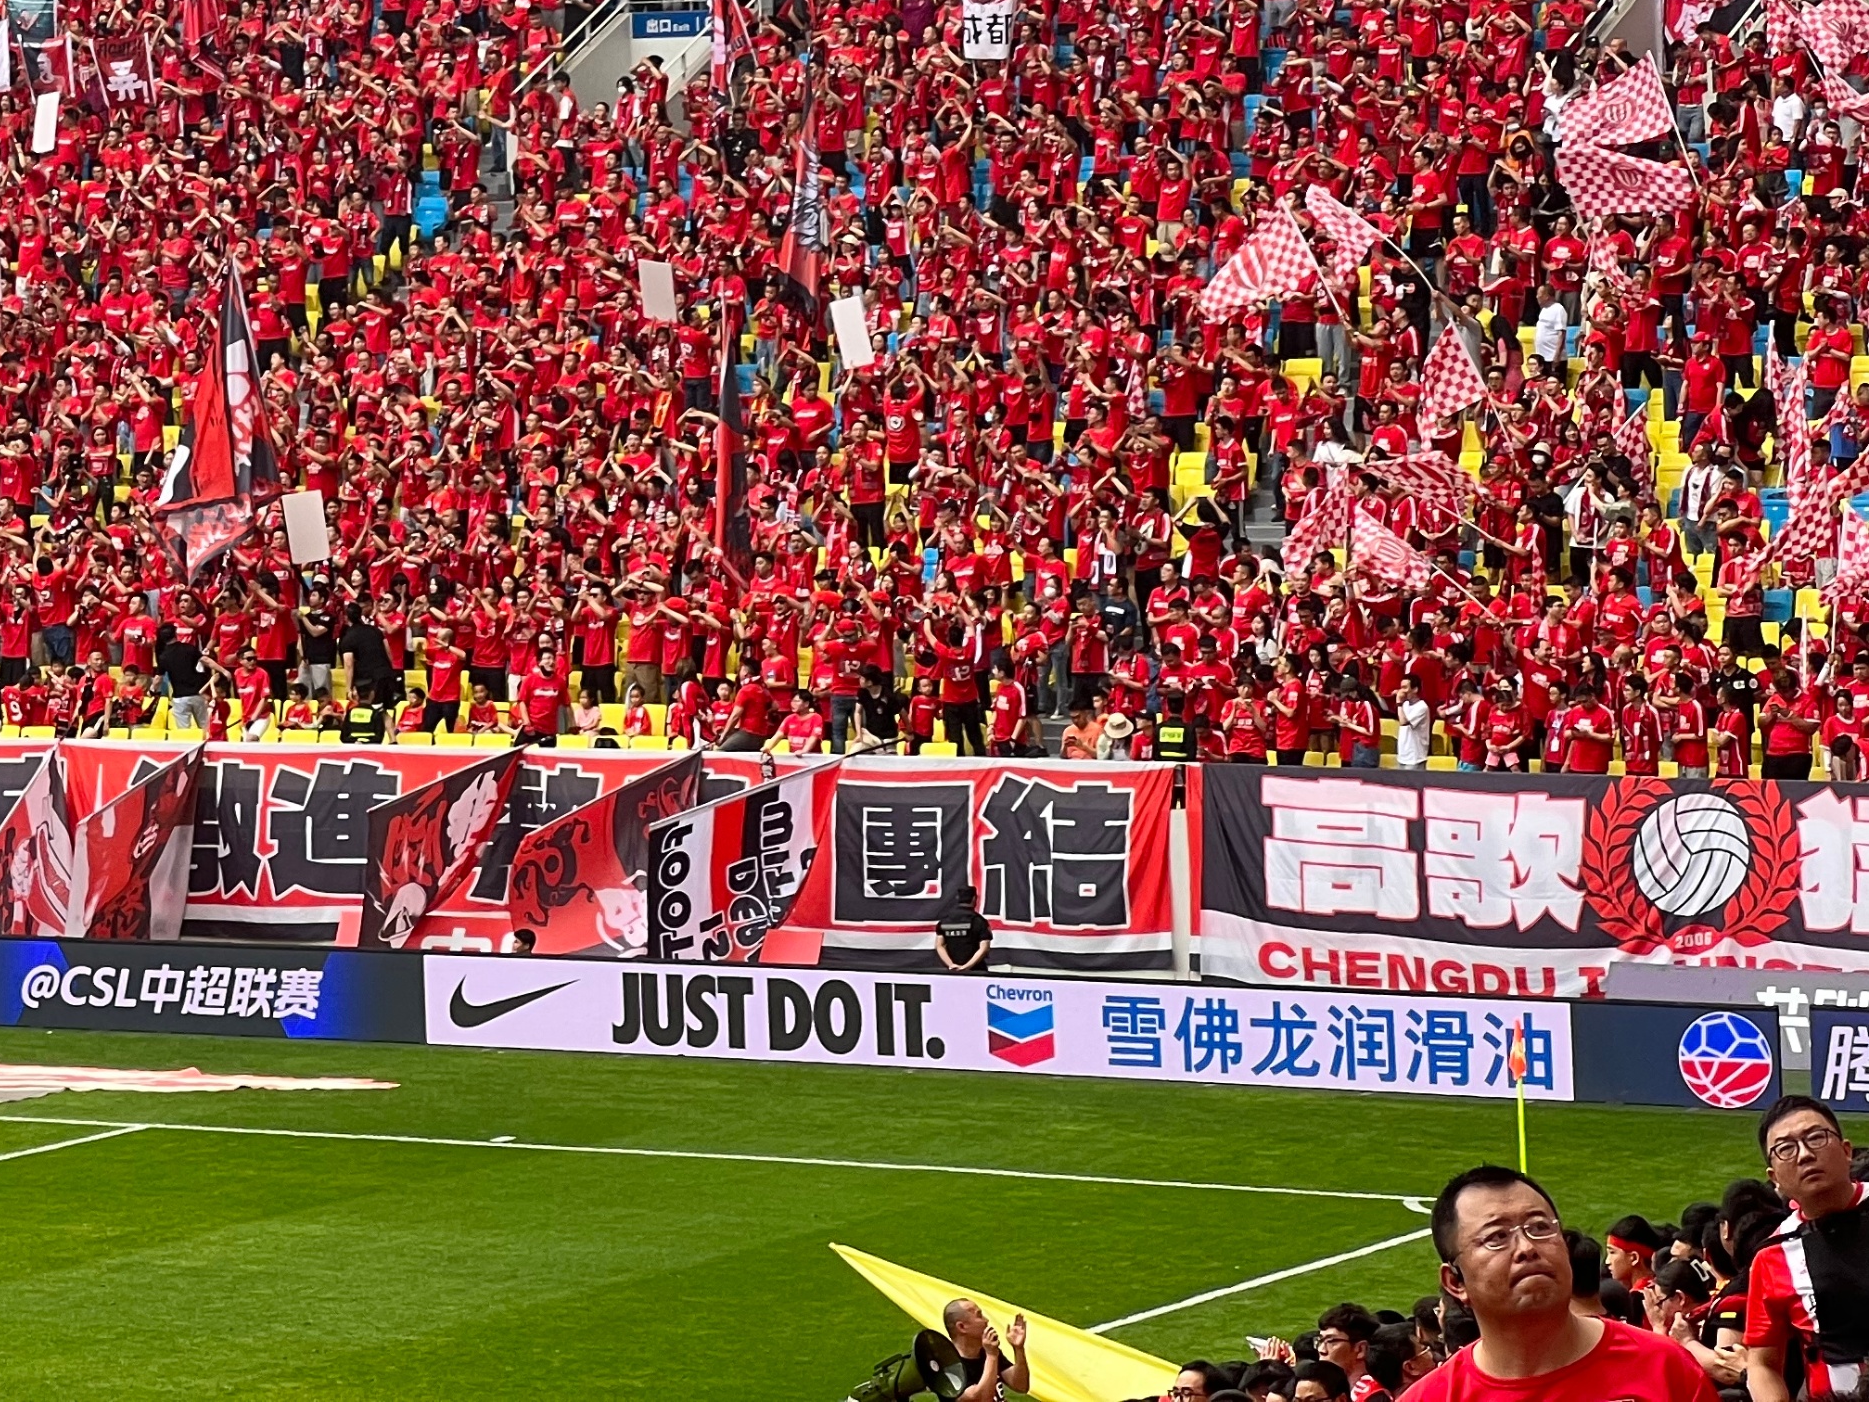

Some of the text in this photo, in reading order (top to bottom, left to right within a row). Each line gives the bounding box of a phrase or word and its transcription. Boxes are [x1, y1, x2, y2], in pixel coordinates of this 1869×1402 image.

[646, 19, 671, 33] 出口
[10, 702, 22, 722] 9
[832, 772, 1133, 931] 團結
[1260, 775, 1587, 933] 高歌
[1675, 931, 1713, 948] 2006
[21, 962, 323, 1020] @CSL中超联赛
[986, 984, 1053, 1003] Chevron
[1257, 940, 1557, 997] CHENGDU
[612, 972, 947, 1060] JUST DO IT.
[1101, 995, 1554, 1092] 雪佛龙润滑油
